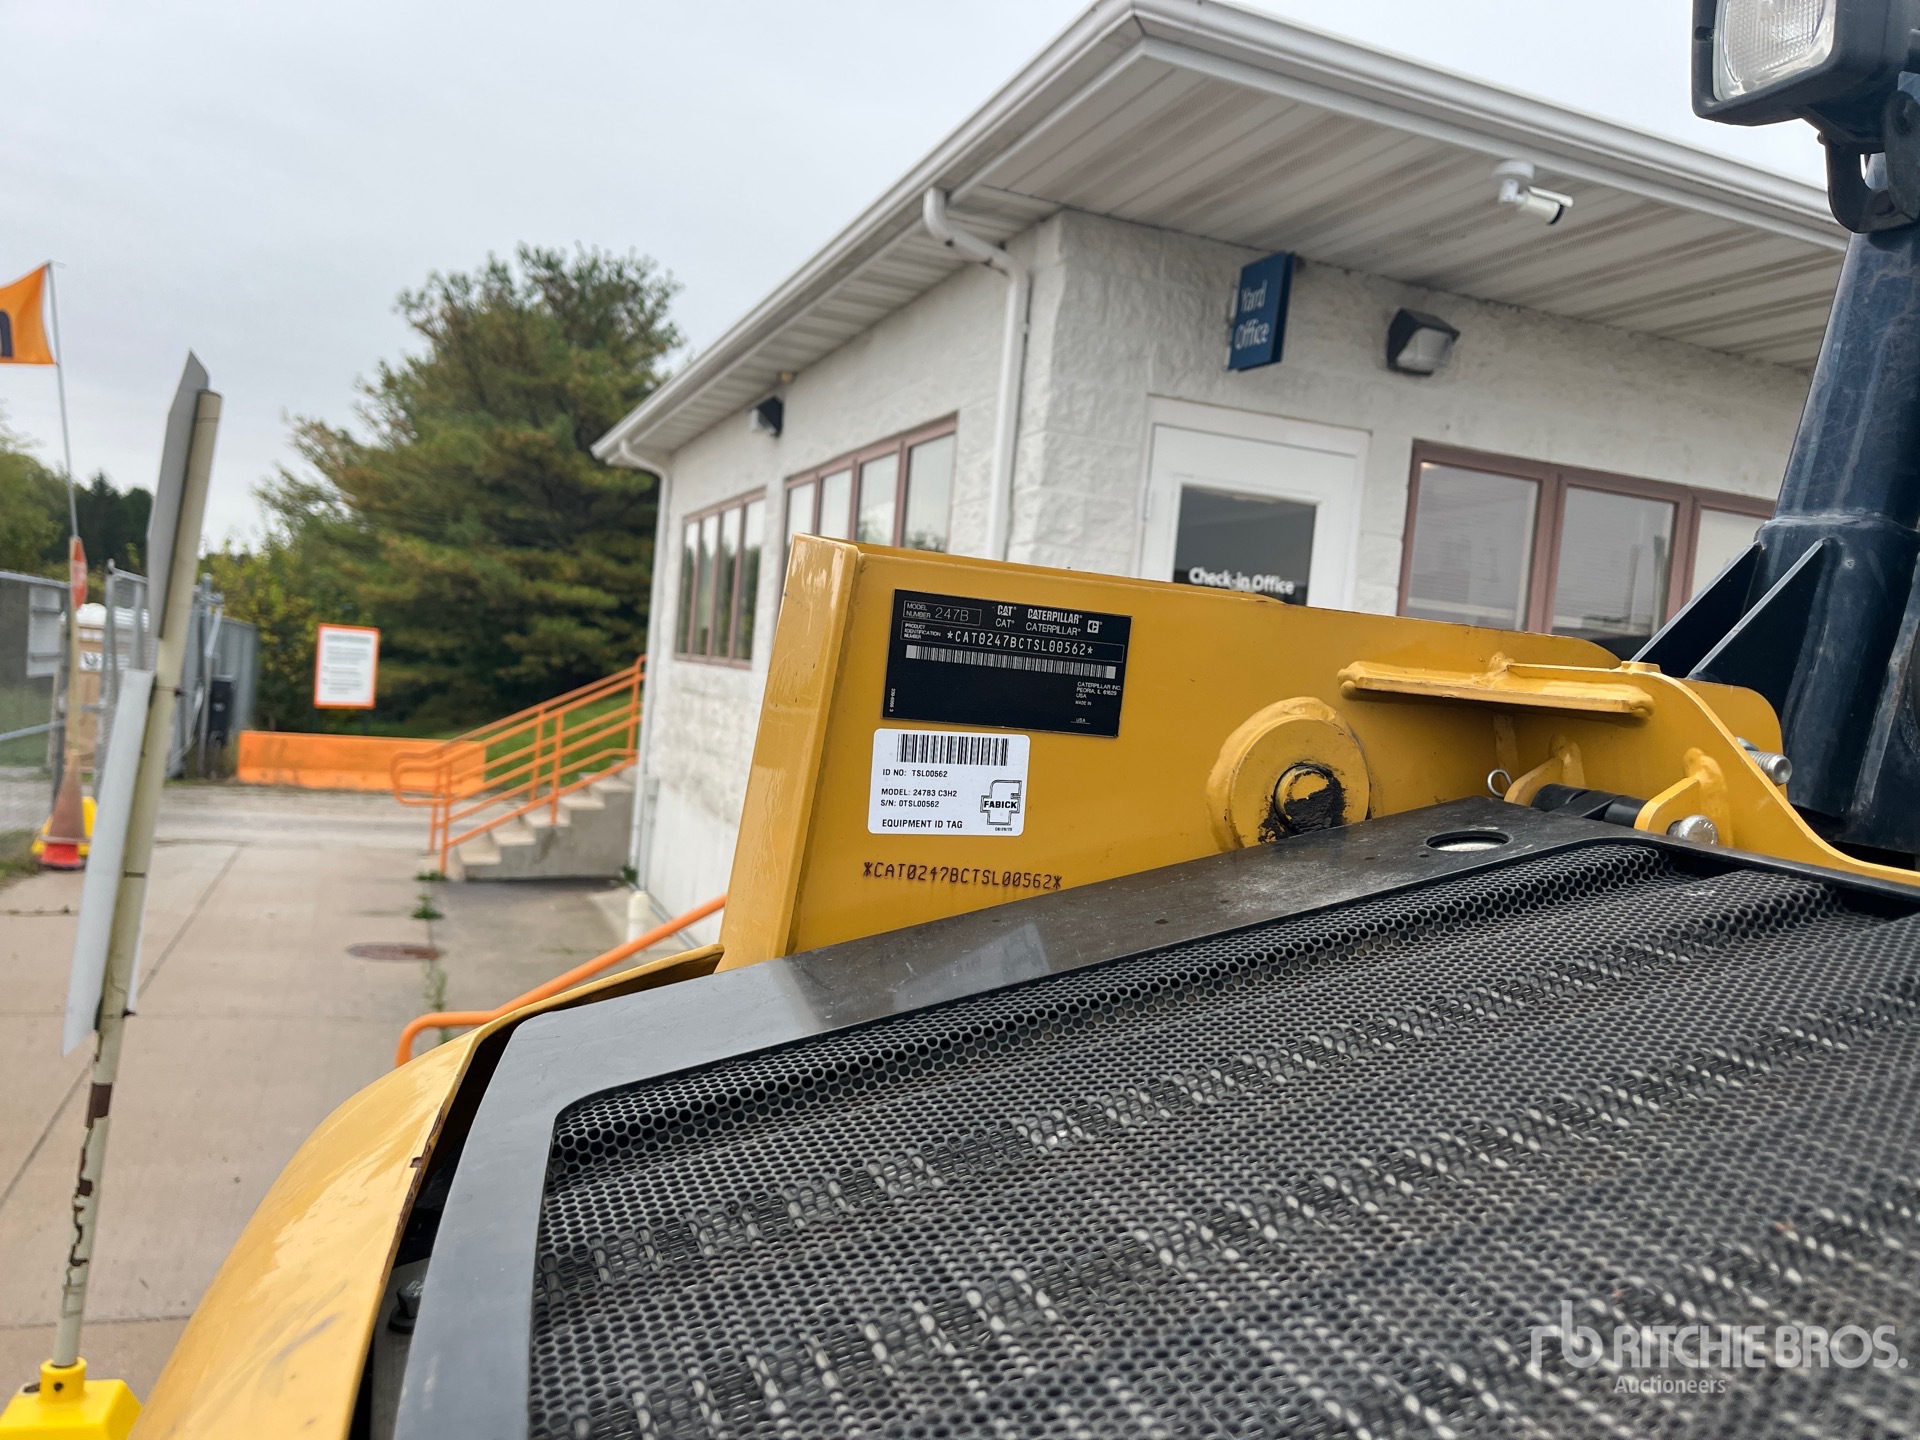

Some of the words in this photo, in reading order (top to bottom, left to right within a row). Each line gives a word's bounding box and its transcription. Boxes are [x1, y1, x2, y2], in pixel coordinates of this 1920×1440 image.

[1241, 279, 1268, 312] Yard
[1234, 318, 1270, 350] Office
[1189, 566, 1250, 590] Check-in
[1252, 574, 1295, 595] Office
[907, 603, 927, 611] MODEL
[935, 607, 969, 621] 247B
[1027, 608, 1080, 625] CATERPILLAR
[904, 629, 942, 637] IDENTIFICATION
[1025, 622, 1079, 636] CATERPILLAR
[1077, 681, 1111, 690] CATERPILLAR
[912, 769, 948, 777] TSL00562
[881, 788, 911, 796] MODEL:
[880, 799, 896, 807] S/N:
[983, 801, 1018, 809] FABICK
[882, 819, 932, 828] EQUIPMENT
[934, 820, 944, 828] ID
[946, 820, 963, 829] TAG
